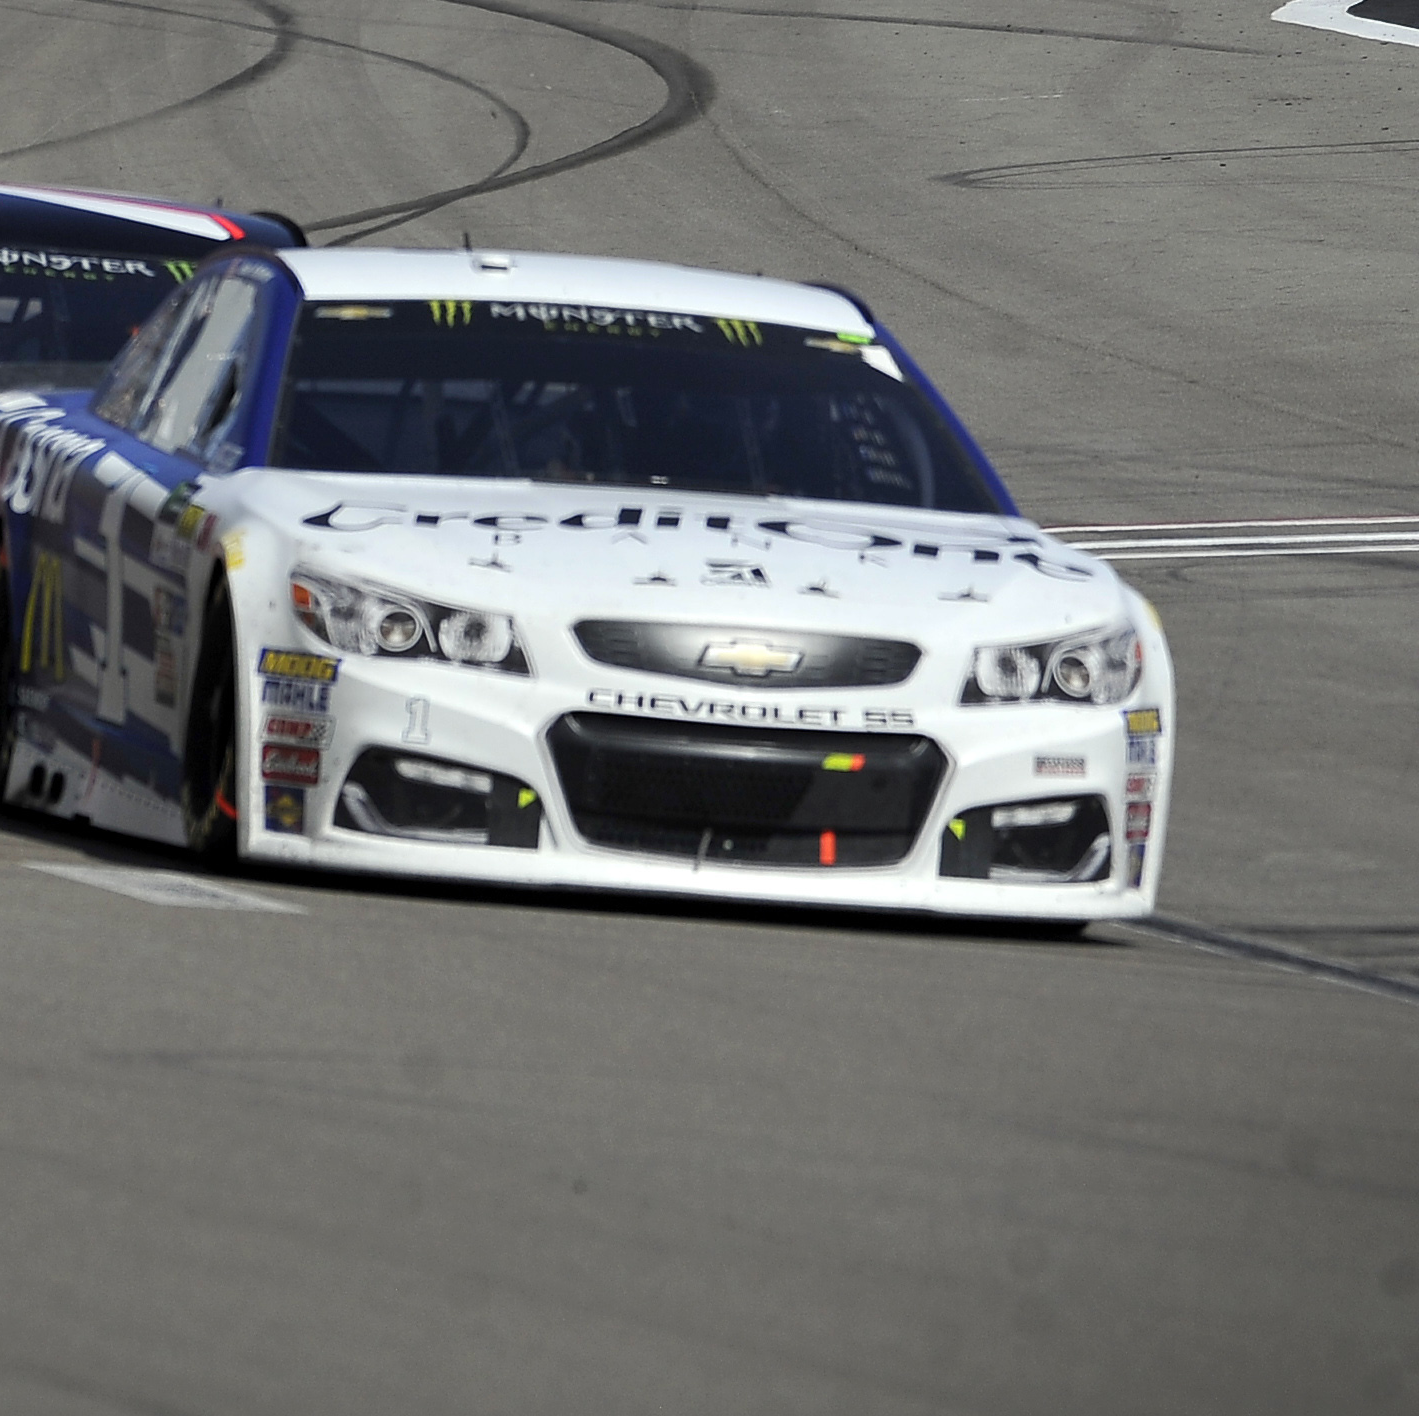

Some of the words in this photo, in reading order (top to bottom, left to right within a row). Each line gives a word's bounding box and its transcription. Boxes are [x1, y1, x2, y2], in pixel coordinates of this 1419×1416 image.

[490, 301, 704, 334] MONSTER
[265, 650, 338, 680] MOOG
[401, 695, 431, 744] 1
[587, 688, 848, 726] CHEVROLET
[862, 710, 915, 728] SS
